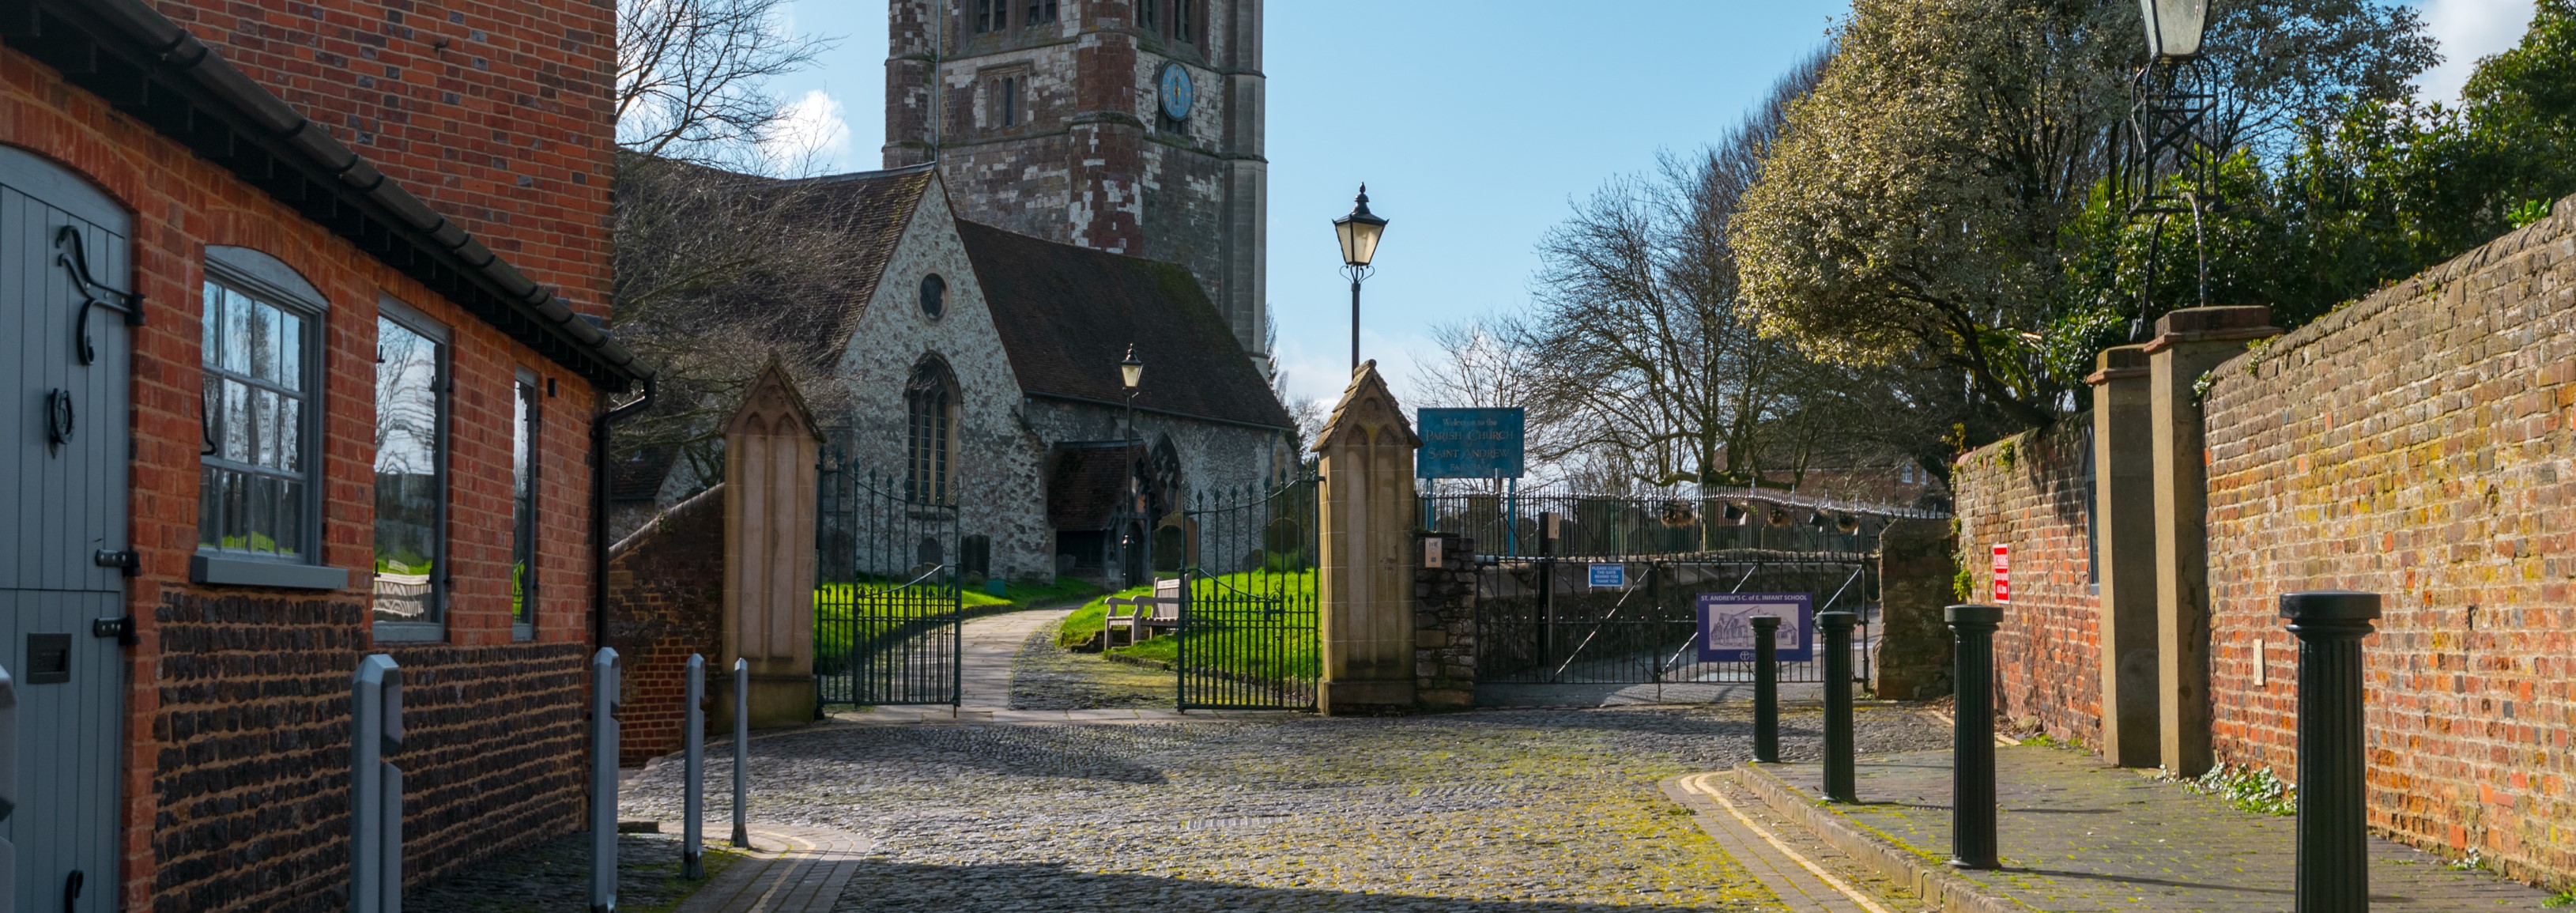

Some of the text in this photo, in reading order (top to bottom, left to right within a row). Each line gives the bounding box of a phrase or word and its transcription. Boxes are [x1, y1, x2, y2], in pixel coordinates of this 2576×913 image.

[1486, 417, 1498, 426] the
[1426, 429, 1514, 442] PARISH CHURCH
[1428, 447, 1510, 459] SAINT ANDREW
